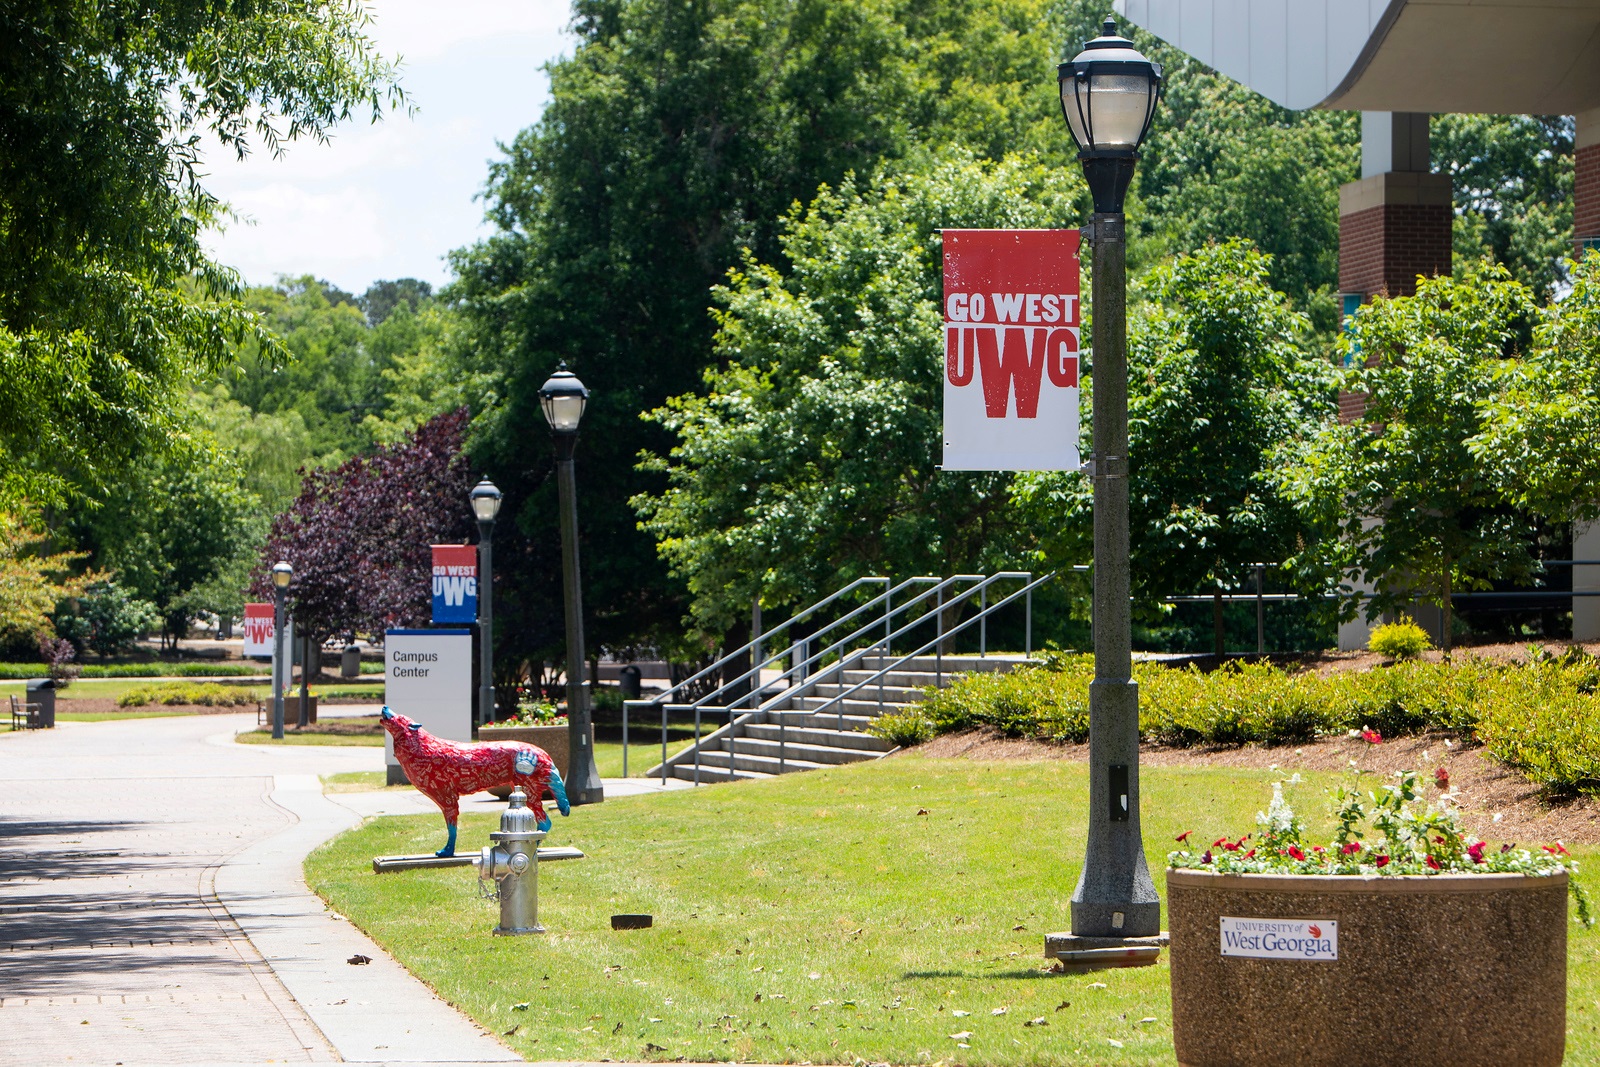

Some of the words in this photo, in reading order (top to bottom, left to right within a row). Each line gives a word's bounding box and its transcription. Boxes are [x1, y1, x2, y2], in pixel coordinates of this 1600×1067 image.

[947, 293, 985, 322] GO
[991, 293, 1078, 322] WEST
[947, 328, 1078, 418] UWG
[432, 565, 446, 576] GO
[447, 565, 476, 576] WEST
[432, 576, 476, 606] UWG
[245, 625, 273, 644] UWG
[393, 650, 438, 664] Campus
[393, 666, 430, 678] Center
[1235, 922, 1294, 933] UNIVERSITY
[1295, 924, 1304, 933] of
[1224, 931, 1260, 950] West
[1262, 933, 1332, 957] Georgia
